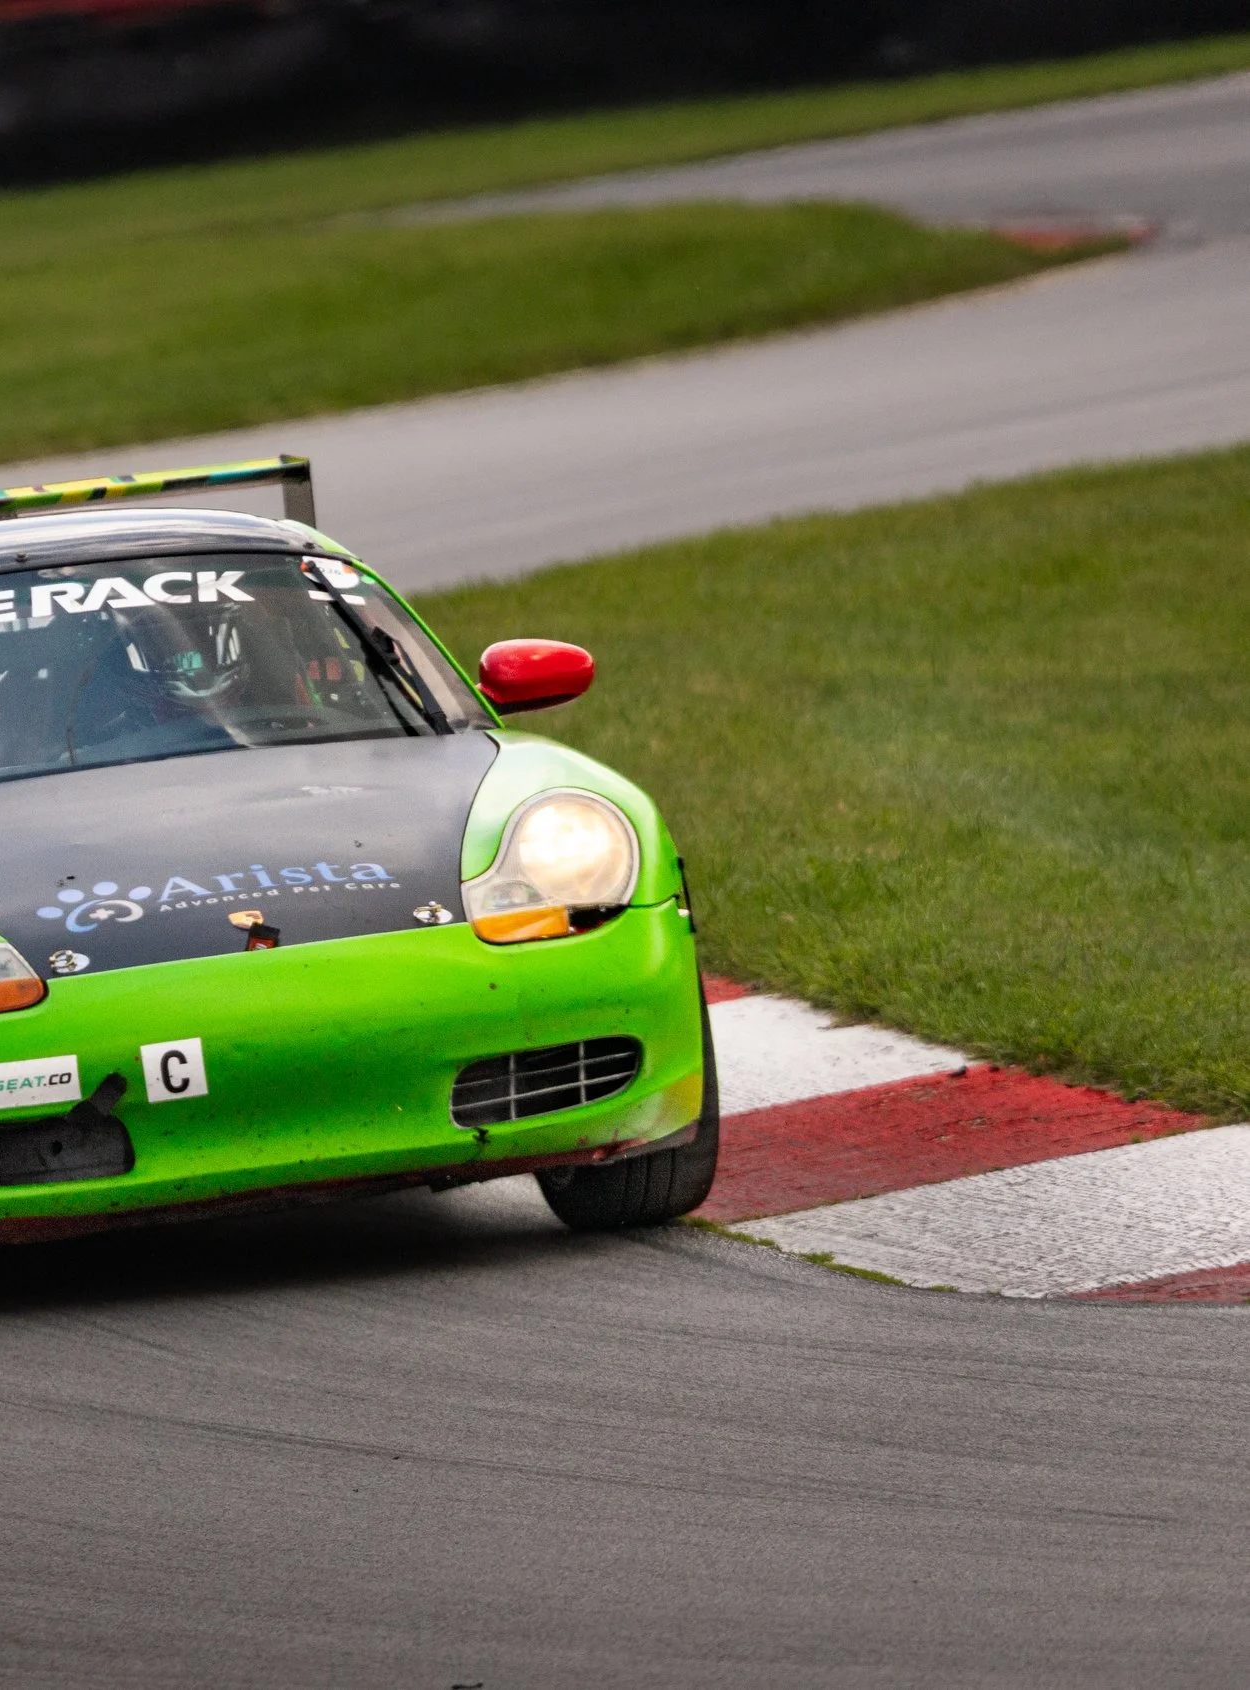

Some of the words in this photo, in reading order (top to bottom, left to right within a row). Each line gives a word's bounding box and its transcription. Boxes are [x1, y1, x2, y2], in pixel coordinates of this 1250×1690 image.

[31, 570, 256, 619] RACK
[158, 861, 394, 902] Arista
[160, 888, 280, 912] Advanced
[293, 884, 331, 894] Pet
[345, 881, 401, 891] Care
[160, 1049, 190, 1094] C
